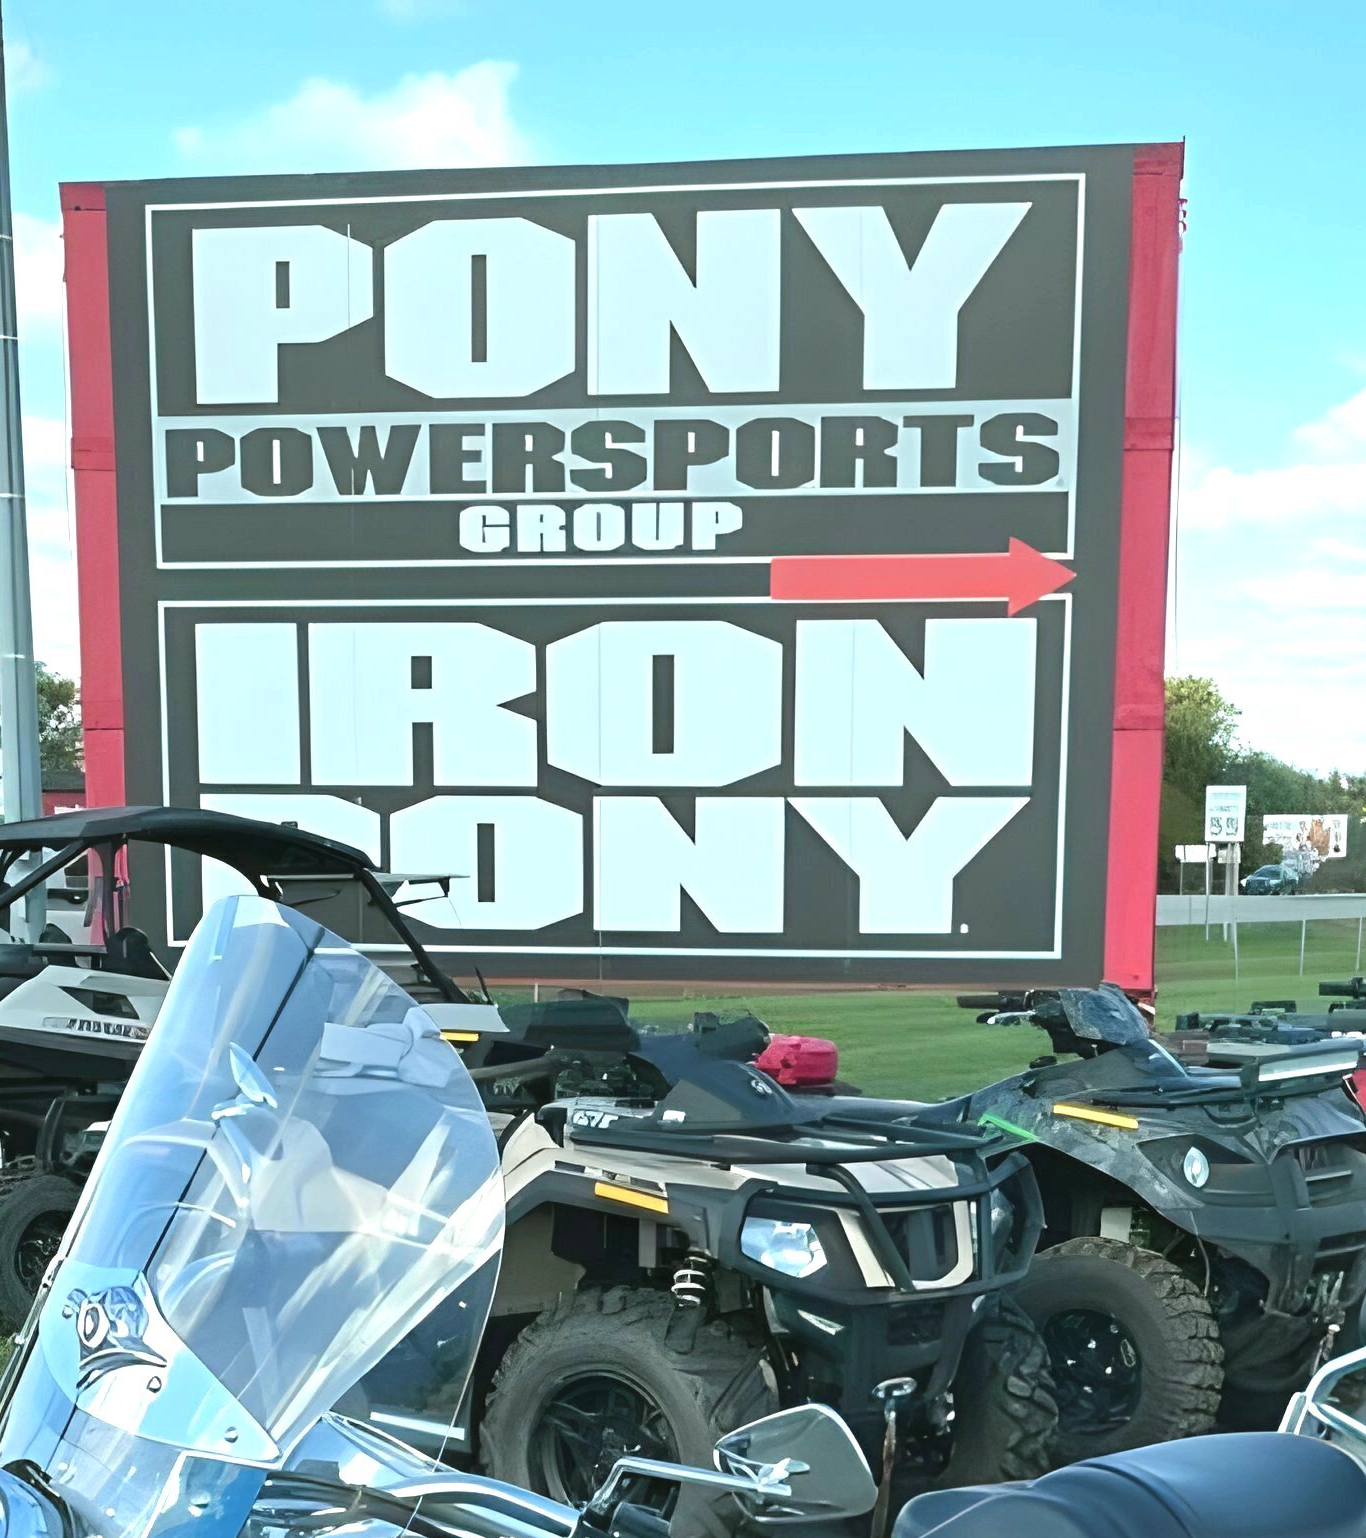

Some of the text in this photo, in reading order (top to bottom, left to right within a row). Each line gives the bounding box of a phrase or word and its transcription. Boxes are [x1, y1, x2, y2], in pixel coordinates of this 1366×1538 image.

[191, 201, 1033, 405] PONY
[165, 412, 1060, 499] POWERSPORTS
[459, 501, 743, 553] GROUP
[194, 617, 1038, 788] IRON
